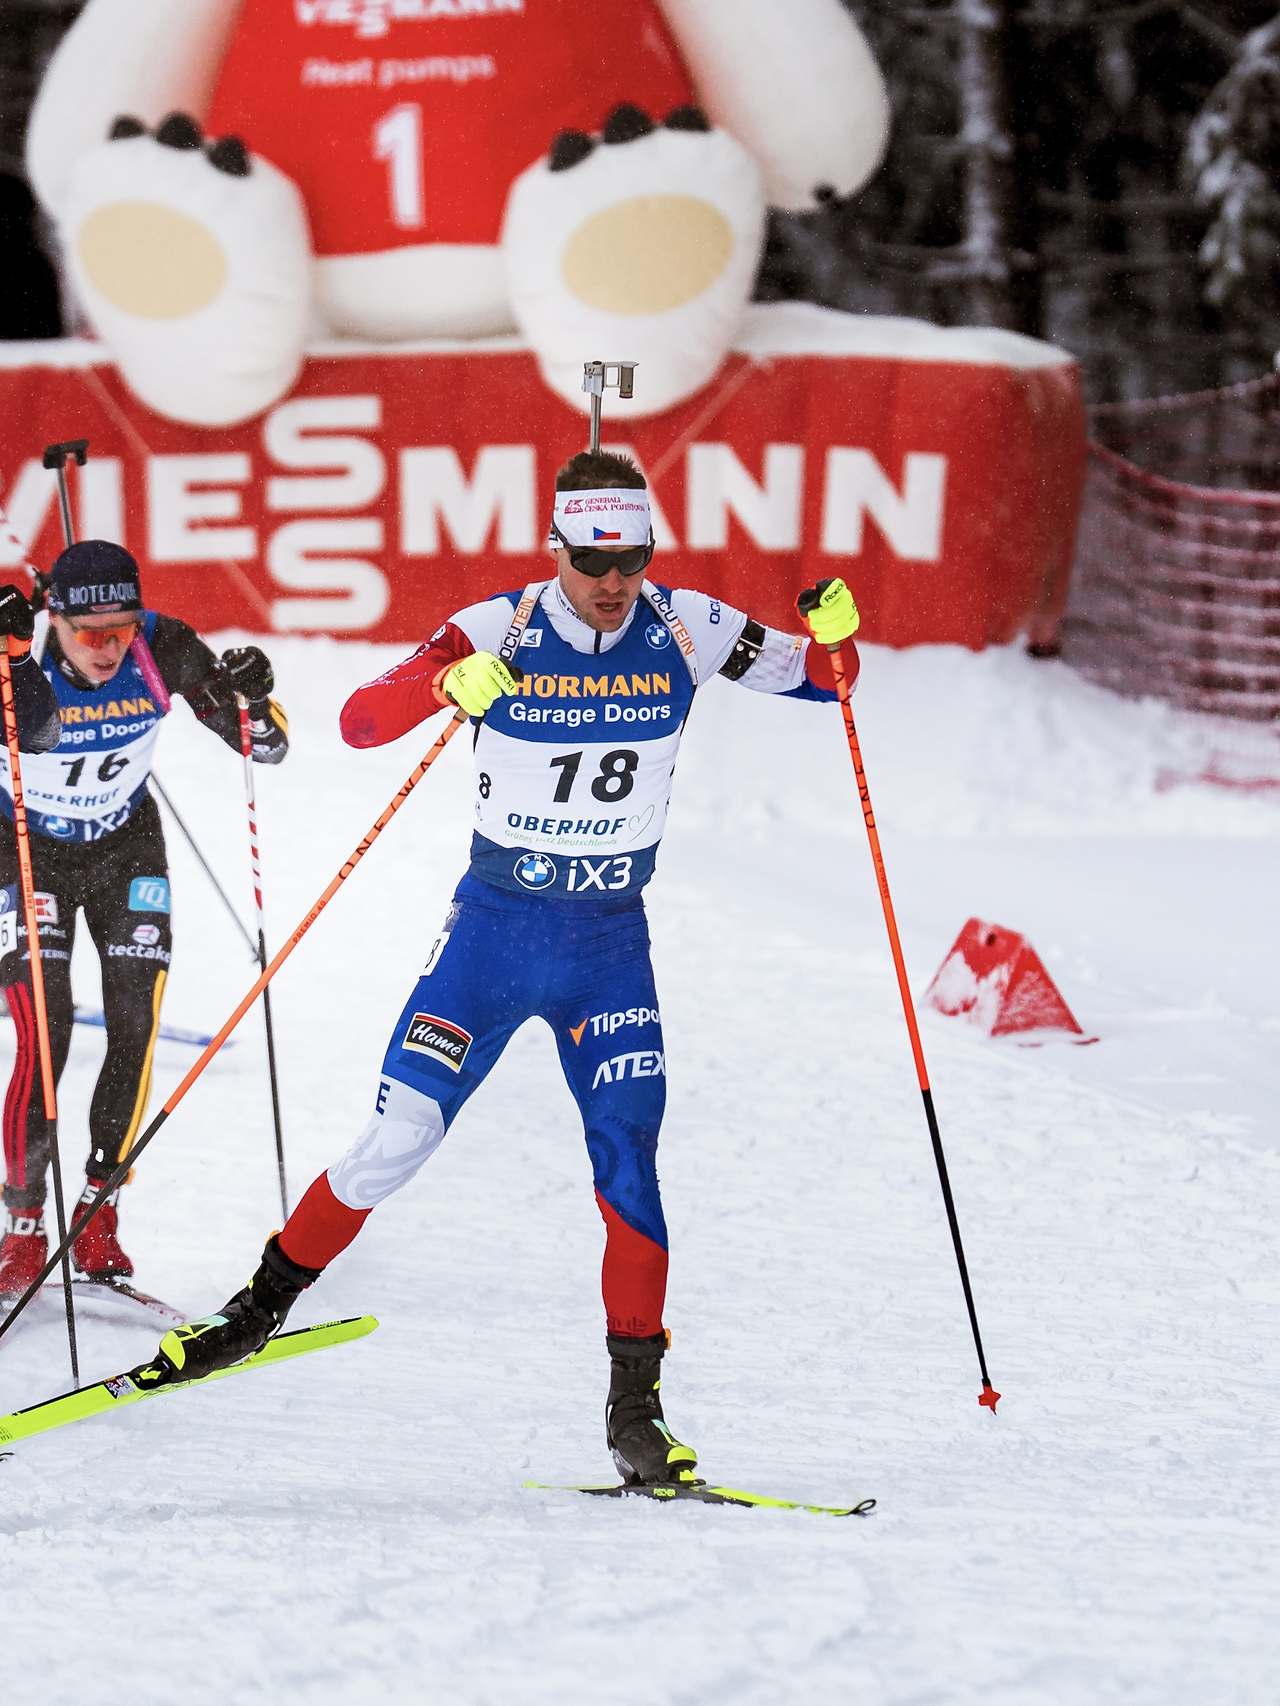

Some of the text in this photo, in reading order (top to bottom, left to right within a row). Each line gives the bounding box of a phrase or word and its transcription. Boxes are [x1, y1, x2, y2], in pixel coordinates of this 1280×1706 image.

[373, 101, 425, 229] 1
[498, 597, 535, 660] OCUTEIN
[651, 592, 697, 657] OCUTEIN
[709, 599, 721, 625] OC
[515, 673, 671, 699] HÖRMANN
[509, 702, 672, 728] Garage Doors
[60, 752, 130, 788] 16
[478, 772, 492, 800] 8
[549, 749, 640, 803] 18
[507, 812, 627, 836] OBERHOF
[567, 856, 634, 892] iX3
[137, 880, 166, 908] TQ
[411, 1022, 464, 1057] Hamé
[591, 1050, 666, 1092] ATEX
